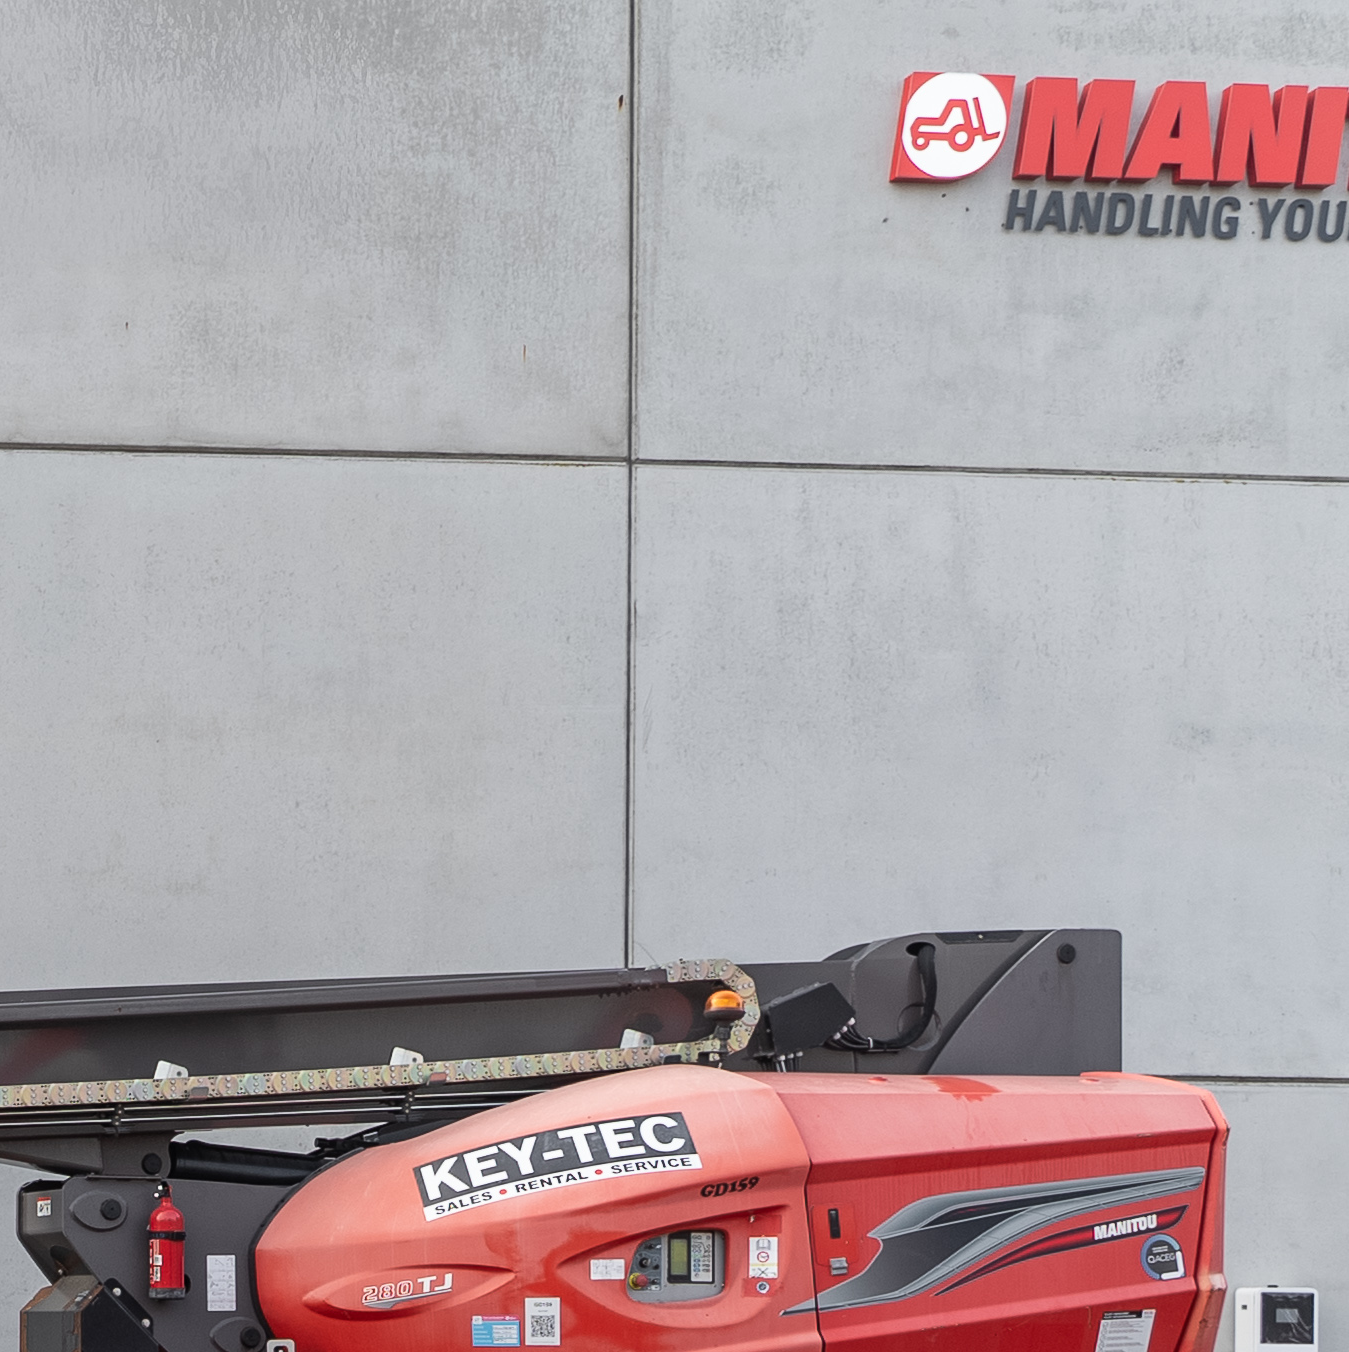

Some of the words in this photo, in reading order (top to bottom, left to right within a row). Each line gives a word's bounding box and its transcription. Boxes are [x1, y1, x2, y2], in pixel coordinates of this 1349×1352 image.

[1012, 77, 1349, 190] MANI
[1005, 188, 1241, 240] HANDLING
[1258, 197, 1349, 243] YOU
[420, 1116, 686, 1201] KEY-TEC
[435, 1191, 492, 1215] SALES
[515, 1171, 588, 1193] RENTAL
[611, 1157, 692, 1174] SERVICE
[700, 1176, 760, 1198] GD159
[1094, 1214, 1157, 1240] MANITOU
[362, 1280, 413, 1303] 280
[417, 1273, 453, 1293] TJ
